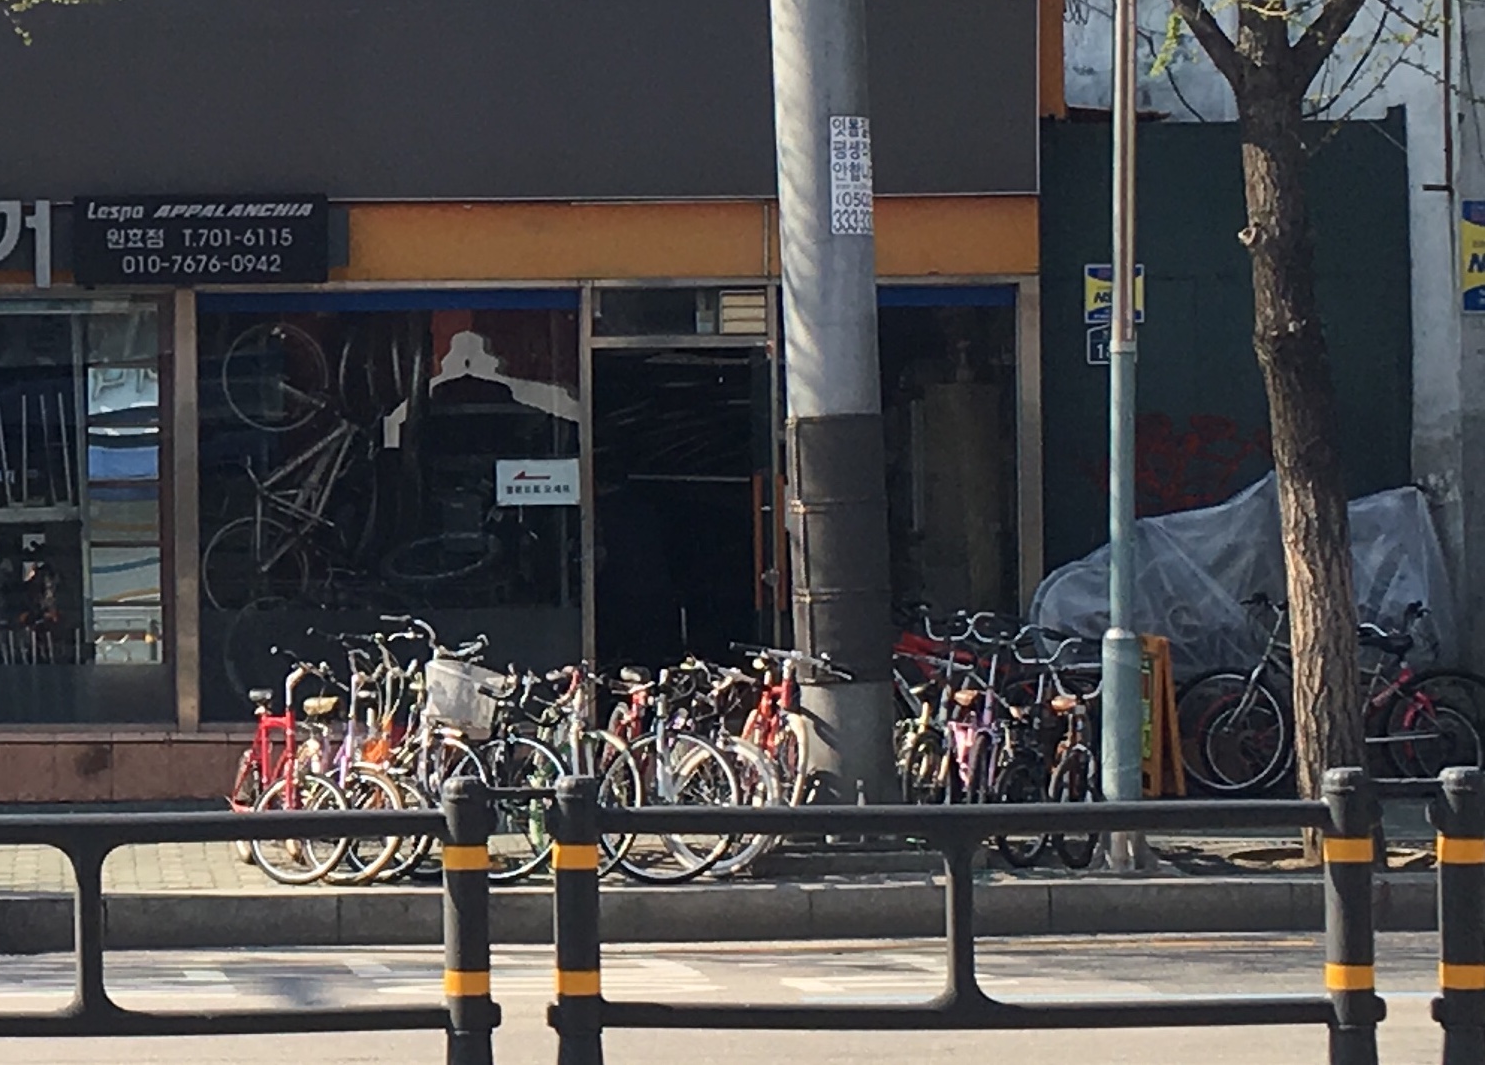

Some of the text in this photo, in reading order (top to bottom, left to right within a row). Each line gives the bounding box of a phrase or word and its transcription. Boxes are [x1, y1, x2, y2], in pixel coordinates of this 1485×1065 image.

[153, 203, 314, 219] APPALANCHIA
[106, 227, 293, 249] 원효점 T.701-6115
[121, 254, 282, 274] 010-7676-0942
